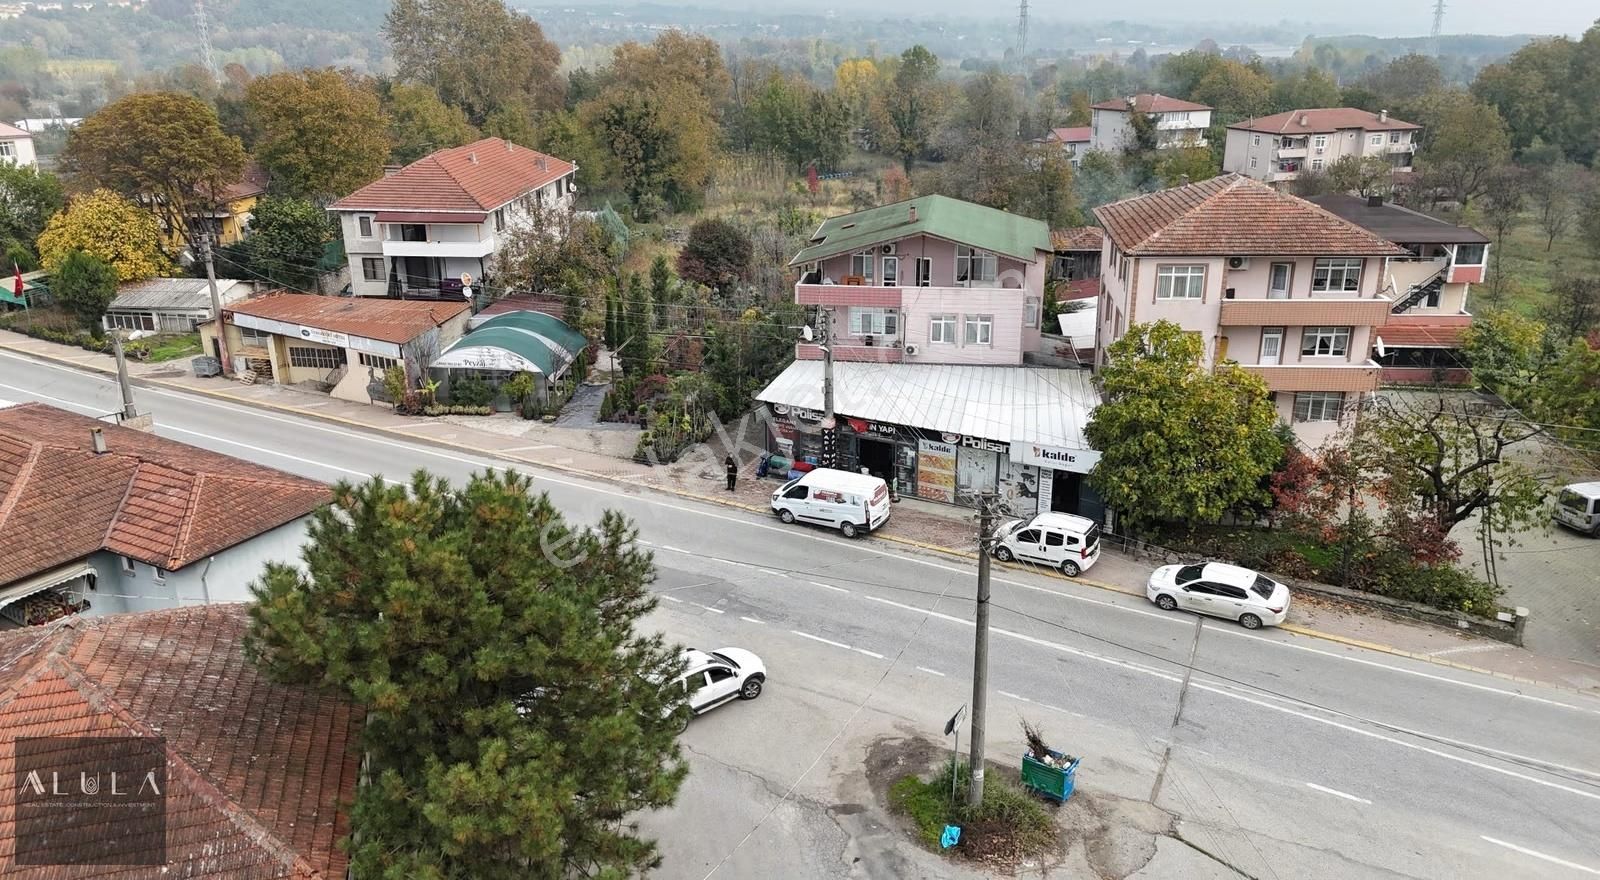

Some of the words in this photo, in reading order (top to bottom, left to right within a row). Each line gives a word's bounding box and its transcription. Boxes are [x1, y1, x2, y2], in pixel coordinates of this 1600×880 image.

[878, 424, 896, 435] YAPI
[928, 443, 951, 453] kalde
[962, 435, 1009, 454] Polisan
[1042, 449, 1076, 463] kalde
